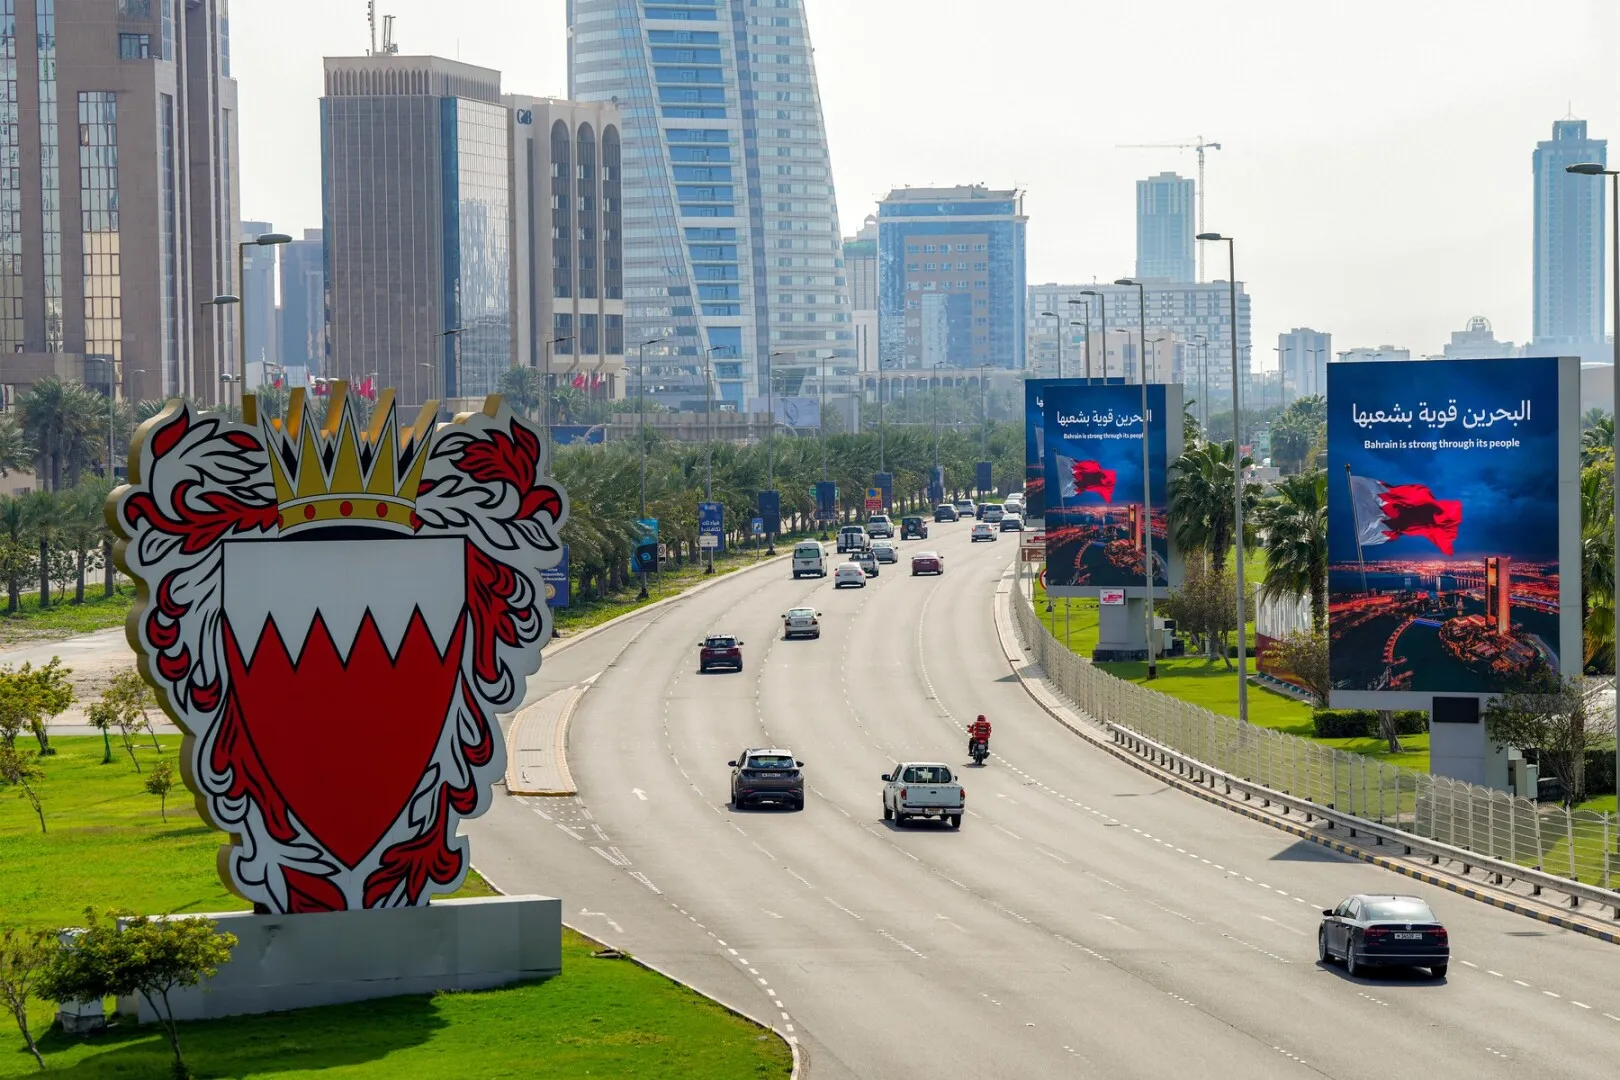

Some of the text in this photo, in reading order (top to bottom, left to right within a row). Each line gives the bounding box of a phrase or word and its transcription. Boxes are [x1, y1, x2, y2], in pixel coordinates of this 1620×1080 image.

[1057, 409, 1152, 427] الحرين قوية بشعبها
[1352, 399, 1531, 429] البحرين قوية بشعبها
[1103, 432, 1123, 440] through
[1130, 432, 1144, 440] peopl
[1364, 438, 1520, 451] Bahrain is strong through its people
